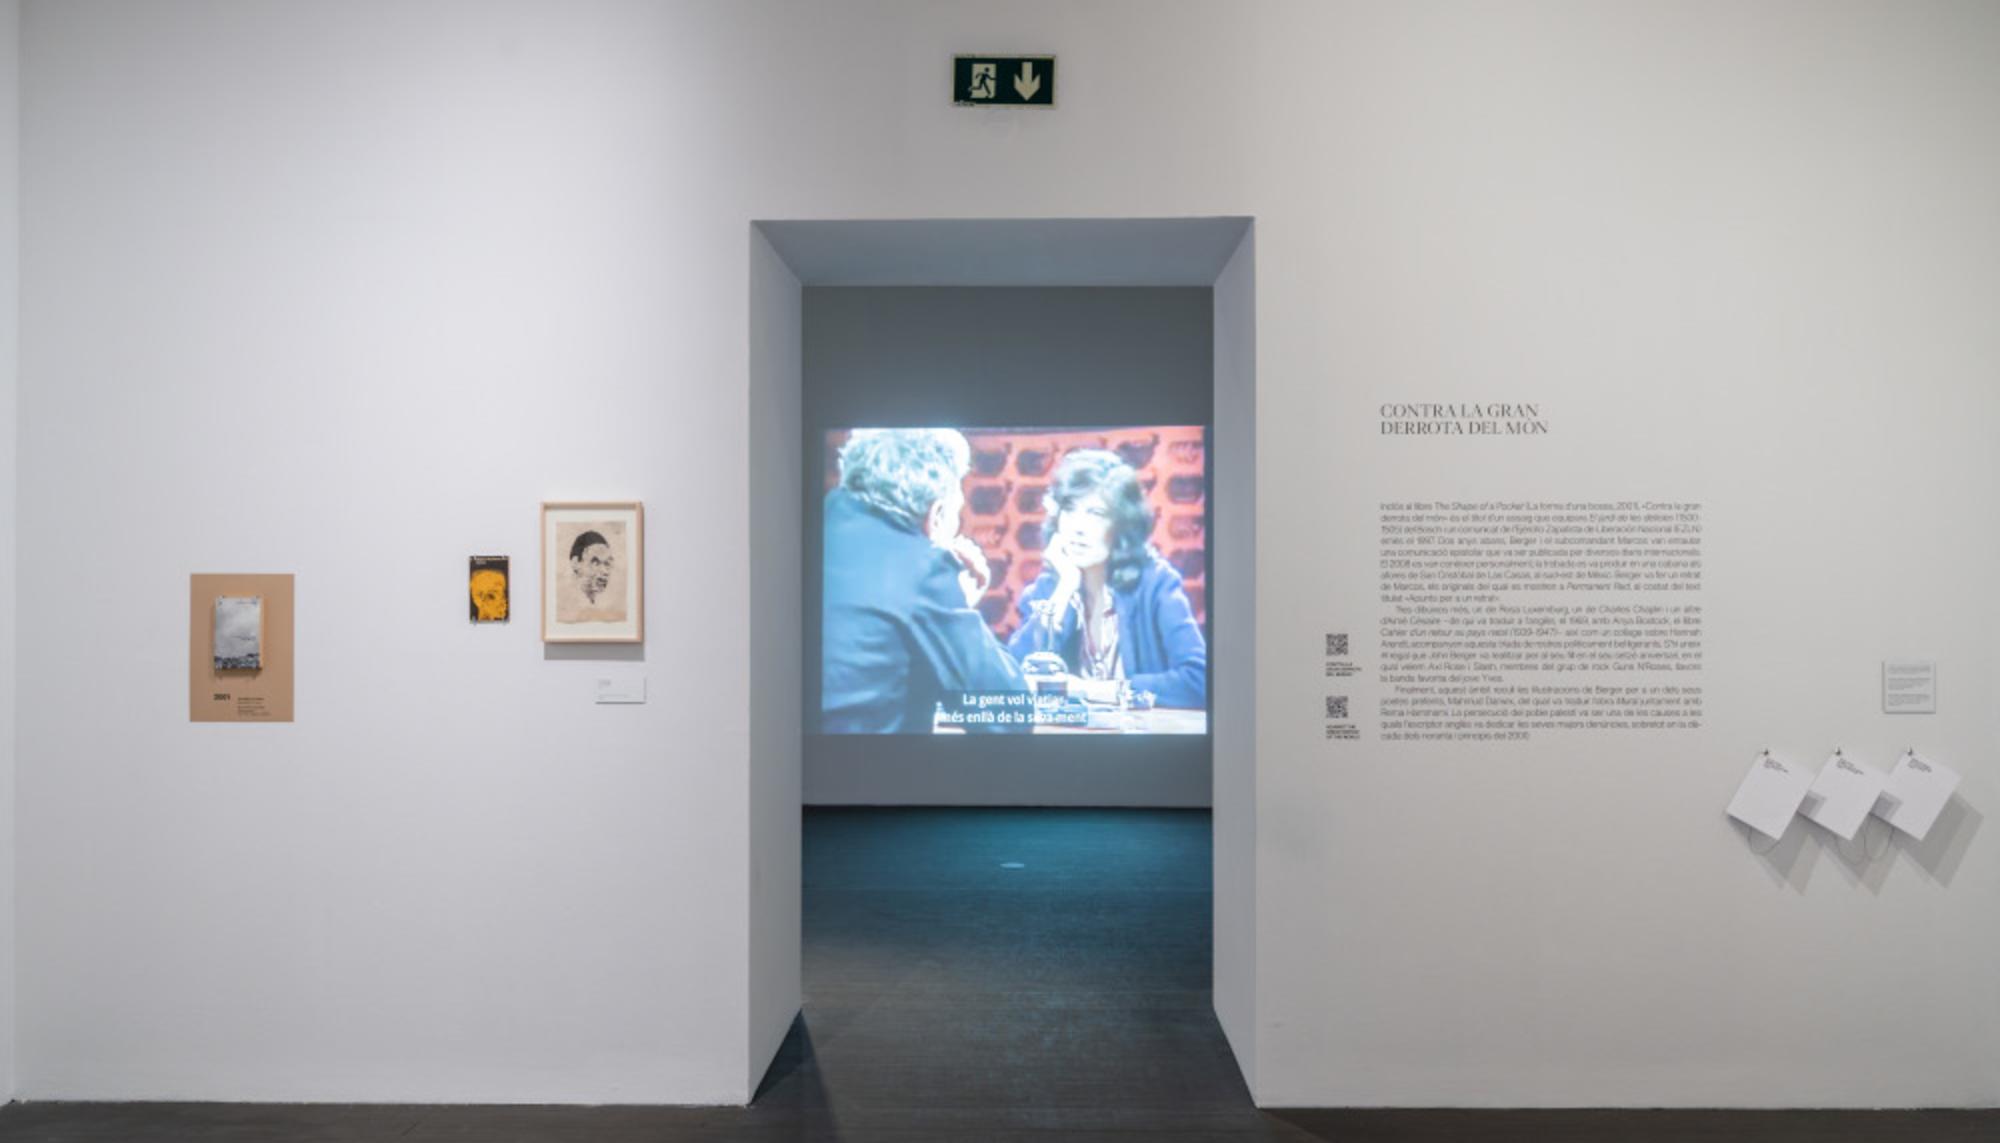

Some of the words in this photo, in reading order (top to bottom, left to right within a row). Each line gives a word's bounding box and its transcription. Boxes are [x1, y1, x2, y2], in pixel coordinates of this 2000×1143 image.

[1380, 404, 1456, 417] CONTRA
[1459, 404, 1484, 417] LA
[1487, 404, 1538, 417] GRAN
[1380, 421, 1463, 434] DERROTA
[1468, 421, 1501, 434] DEL
[1505, 418, 1548, 434] MÓN
[963, 694, 977, 705] La
[979, 694, 1005, 708] gent
[1007, 694, 1024, 705] vol
[966, 710, 995, 723] enllà
[997, 711, 1011, 723] de
[1013, 711, 1026, 723] la
